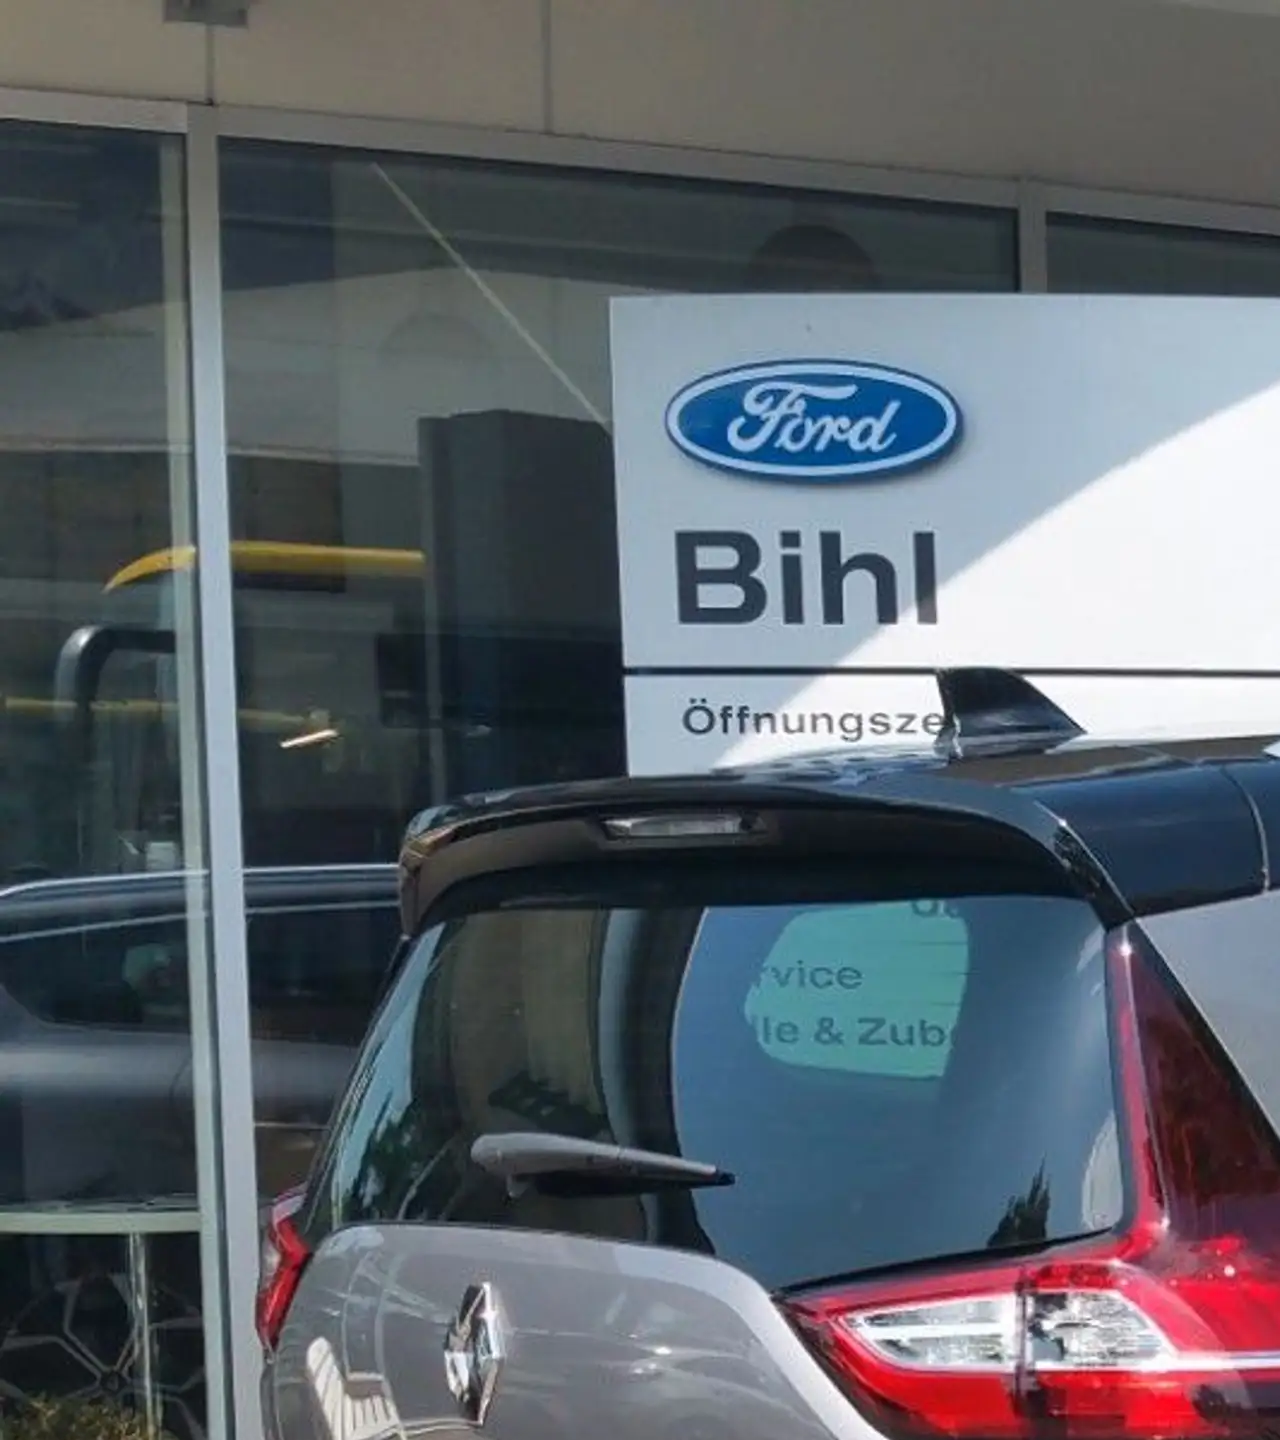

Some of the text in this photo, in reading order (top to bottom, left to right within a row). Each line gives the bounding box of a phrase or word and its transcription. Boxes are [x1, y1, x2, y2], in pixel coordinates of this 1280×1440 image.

[727, 381, 901, 452] Ford
[675, 530, 938, 625] Bihl
[814, 1016, 845, 1045] &
